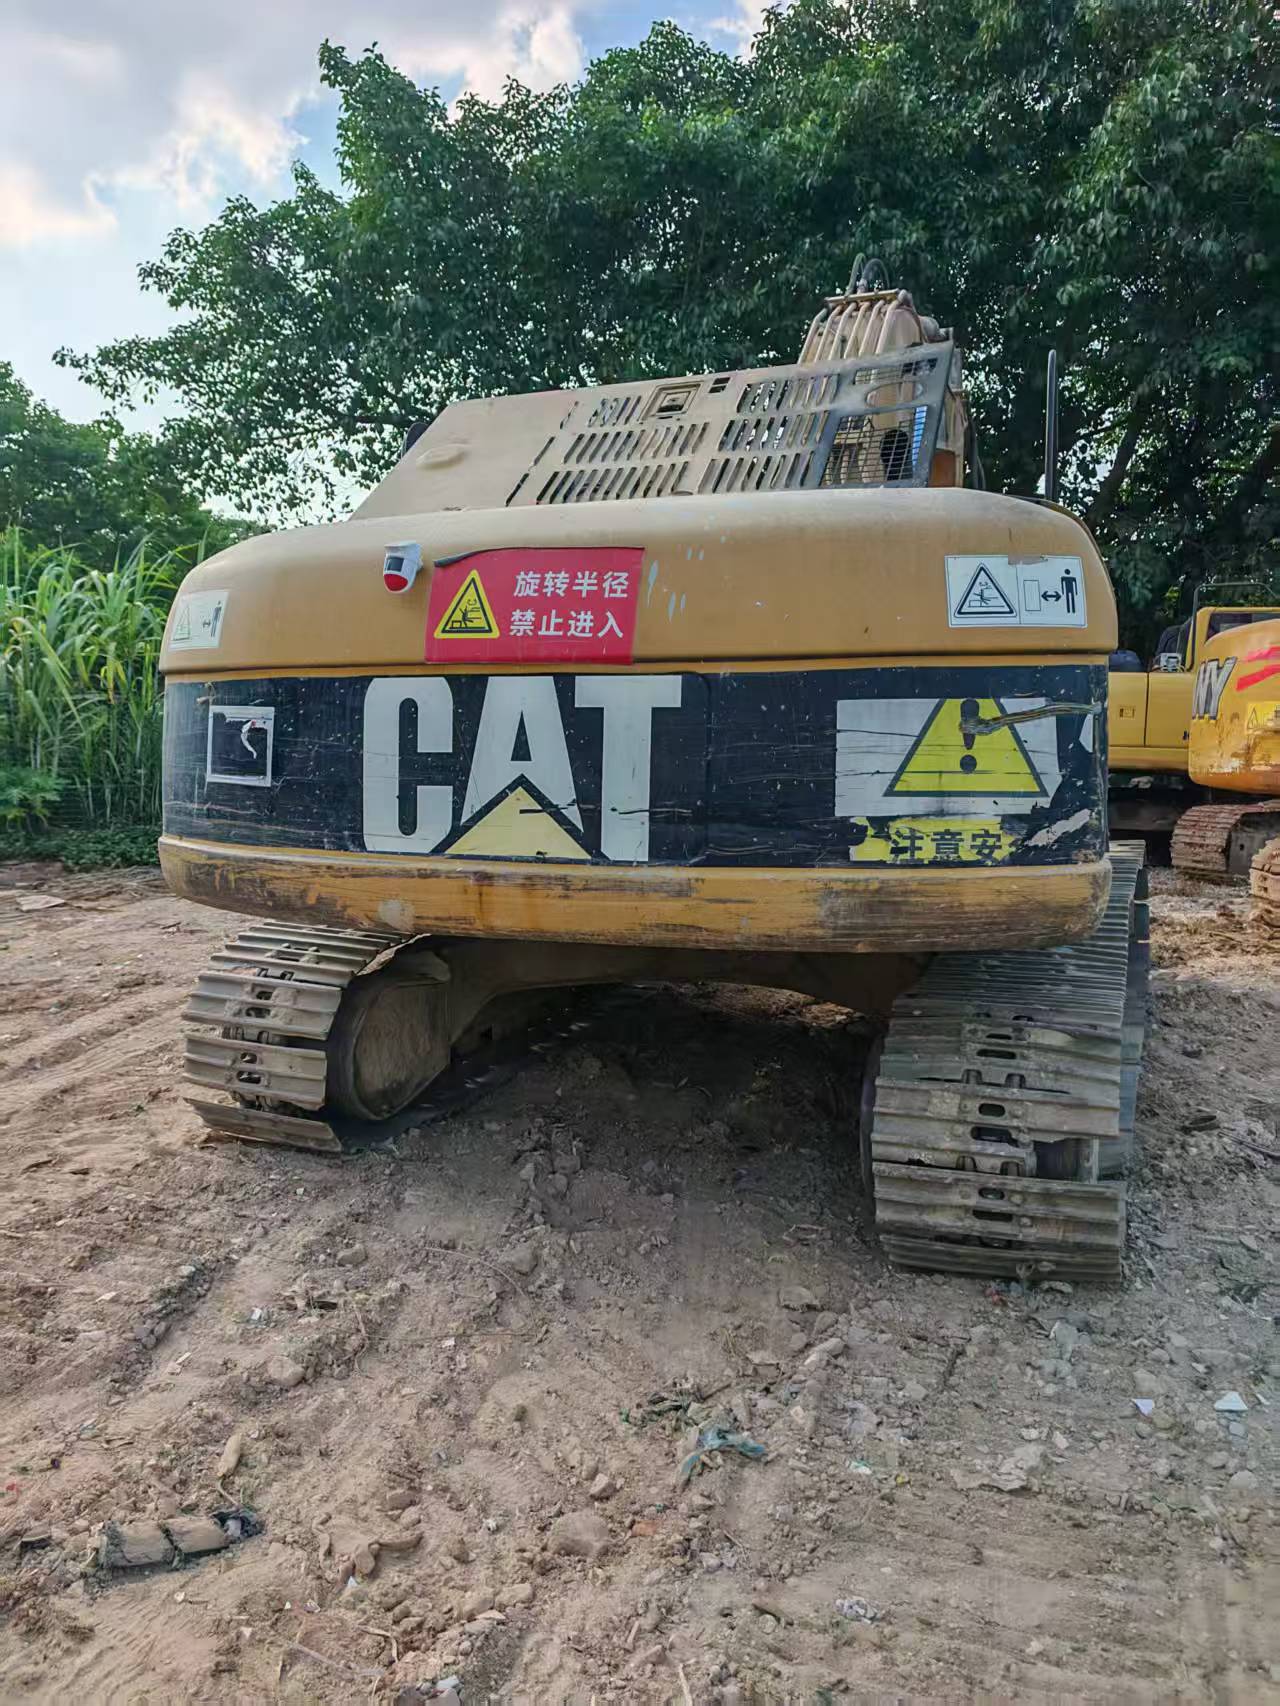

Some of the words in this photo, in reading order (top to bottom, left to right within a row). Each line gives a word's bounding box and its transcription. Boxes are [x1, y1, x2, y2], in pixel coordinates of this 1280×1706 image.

[513, 570, 629, 599] 旋转半径
[509, 609, 624, 638] 禁止进入
[363, 675, 682, 862] CAT
[890, 828, 1020, 866] 注意安
